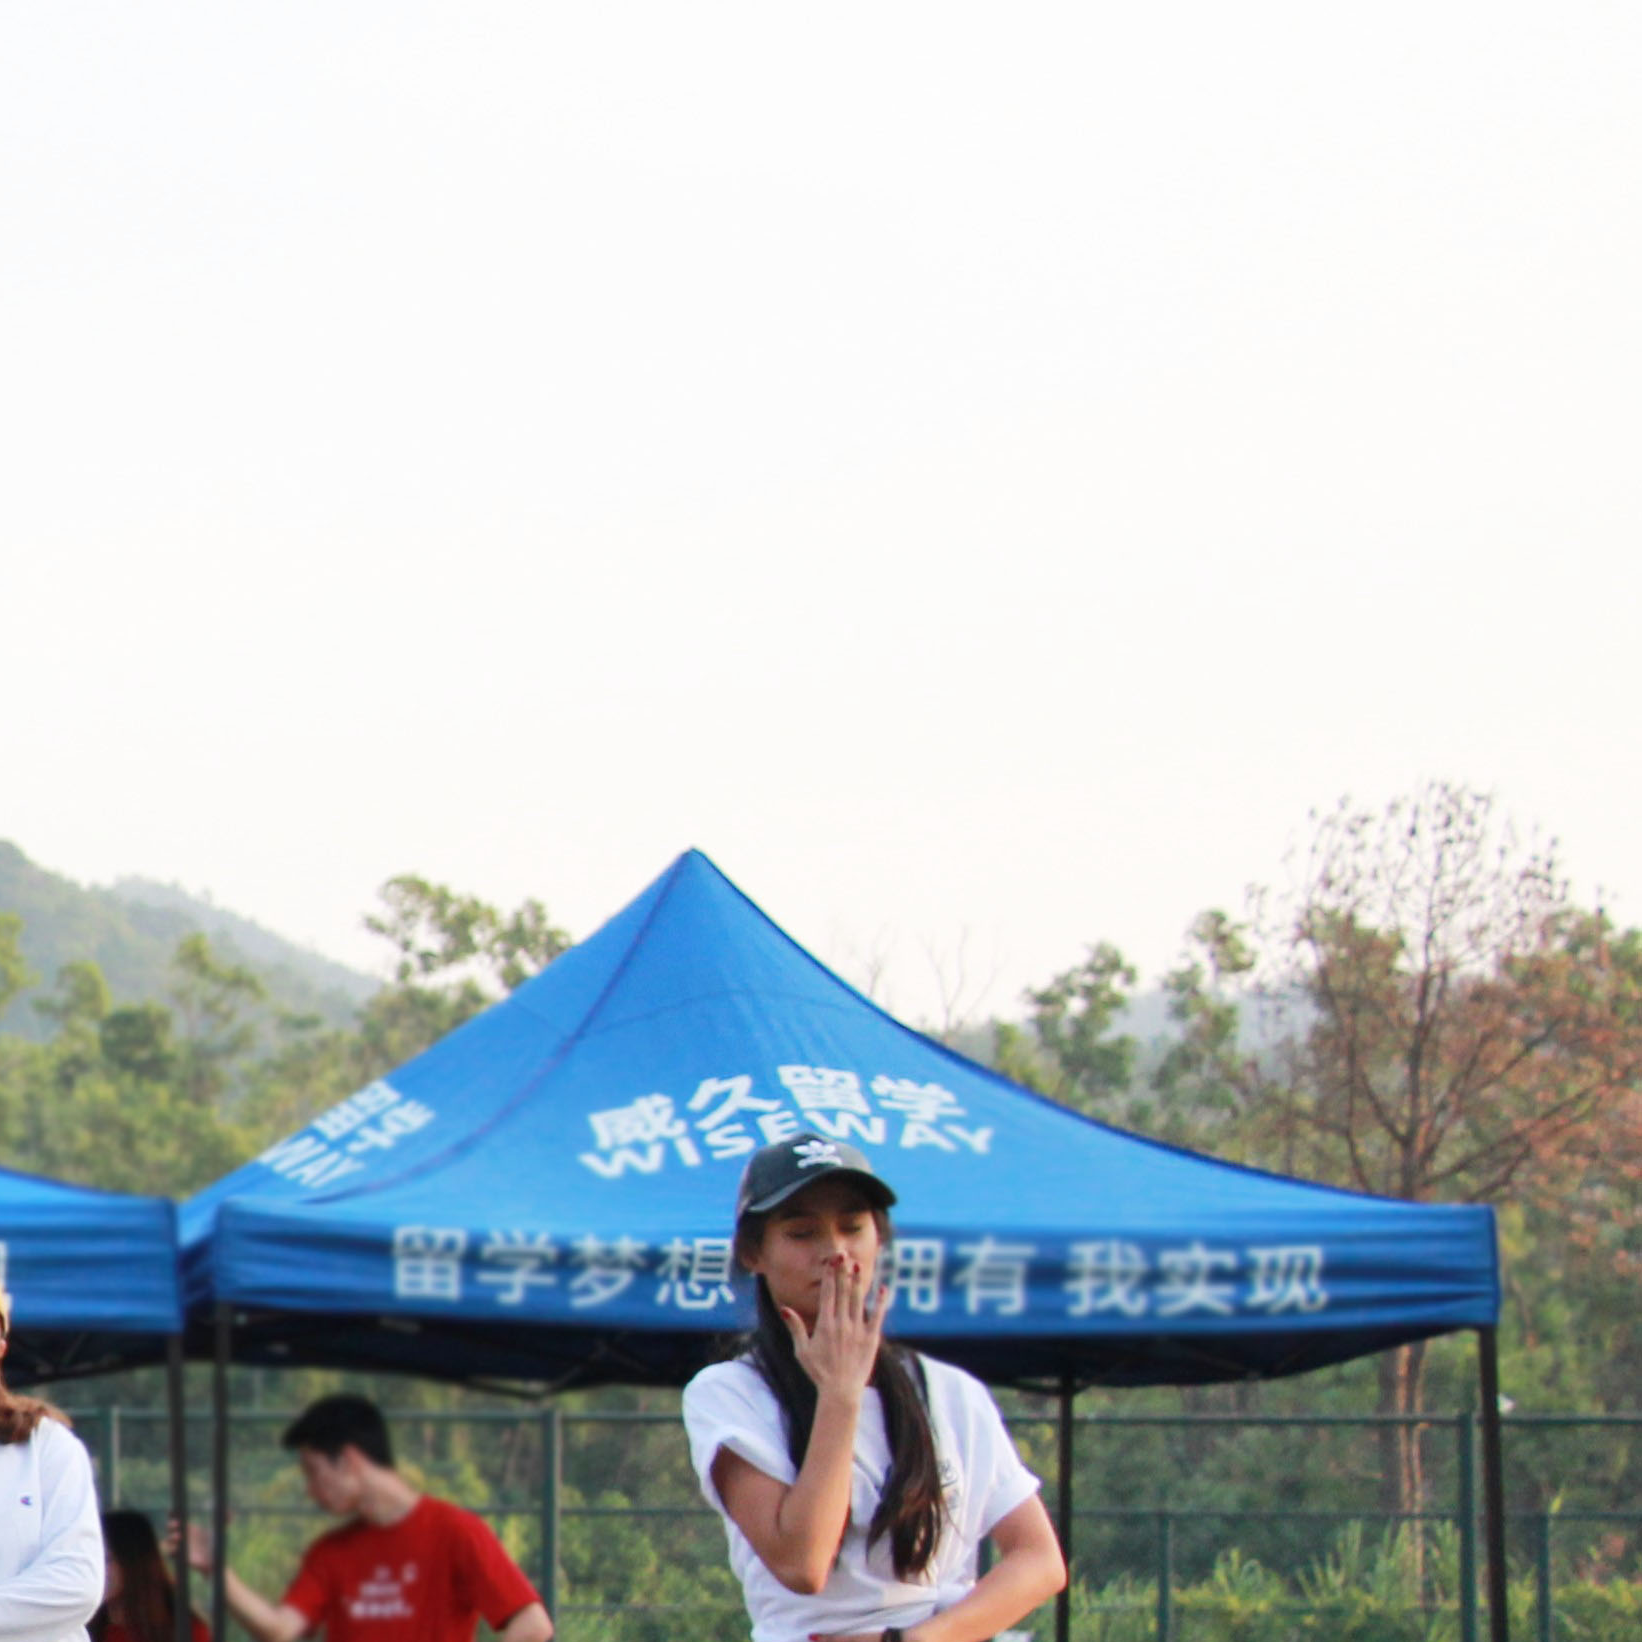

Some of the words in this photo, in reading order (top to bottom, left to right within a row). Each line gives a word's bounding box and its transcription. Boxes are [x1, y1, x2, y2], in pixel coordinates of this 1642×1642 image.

[579, 1111, 994, 1179] WISEWAY
[587, 1065, 967, 1150] 威久留学
[1063, 1239, 1329, 1316] 我实现
